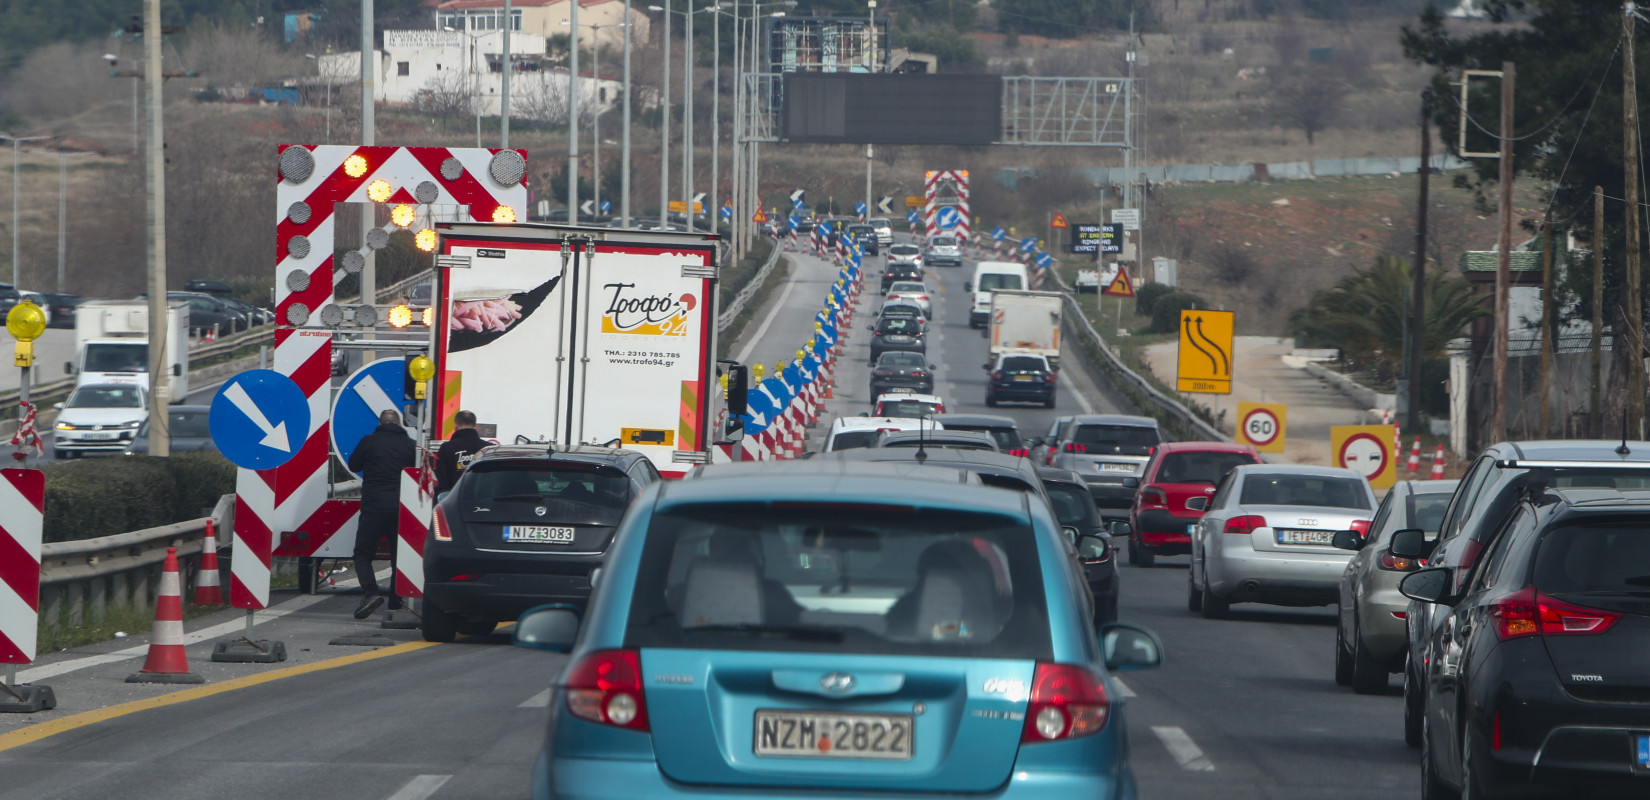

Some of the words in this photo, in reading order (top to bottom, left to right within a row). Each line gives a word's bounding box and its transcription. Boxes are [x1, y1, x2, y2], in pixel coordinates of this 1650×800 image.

[660, 320, 688, 336] 94
[609, 358, 675, 367] www.trofo94.gr
[1250, 419, 1272, 435] 60
[1571, 674, 1604, 682] TOYOTA
